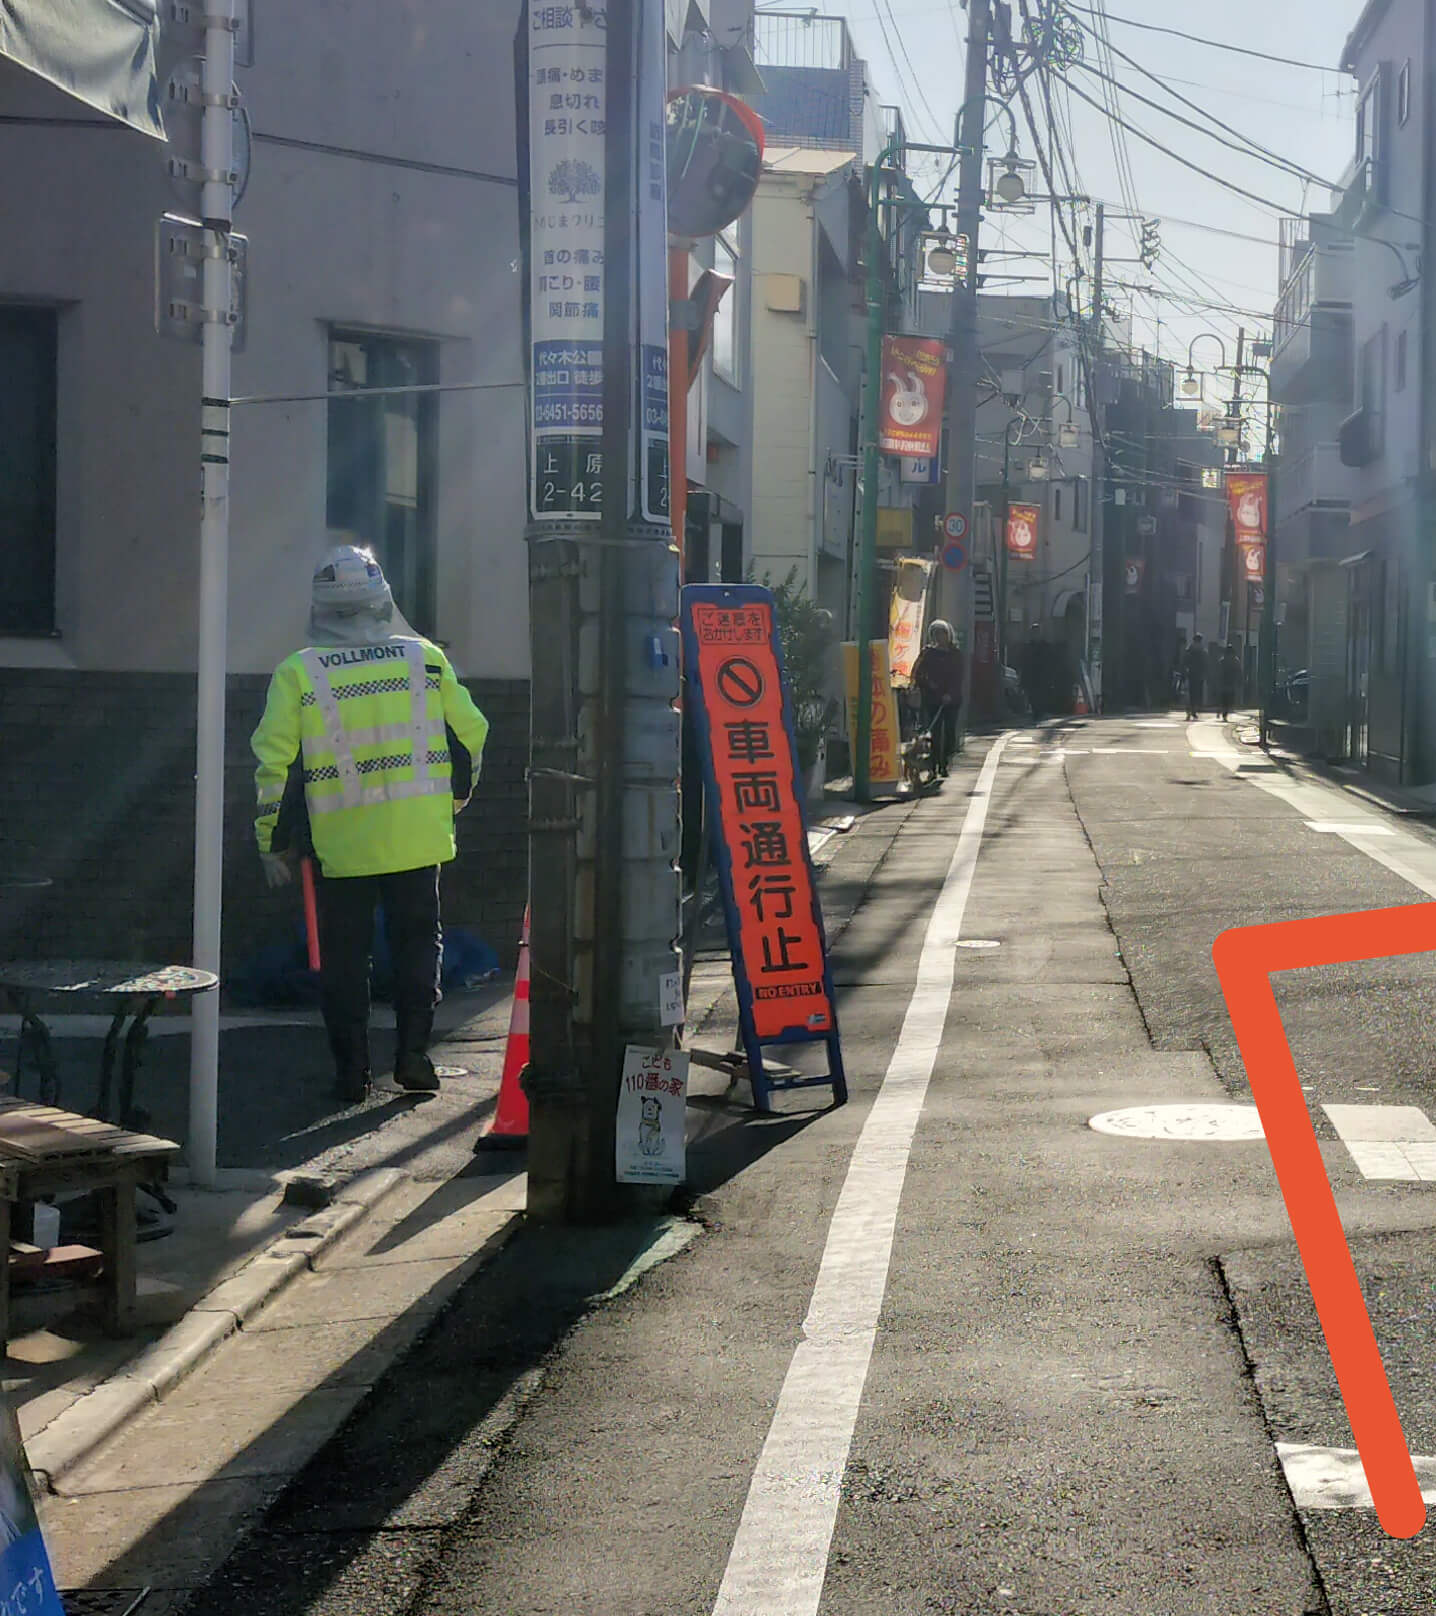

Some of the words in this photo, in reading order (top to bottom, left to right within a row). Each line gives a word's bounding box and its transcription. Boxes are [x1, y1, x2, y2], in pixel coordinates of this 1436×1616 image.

[544, 482, 603, 502] 2-42
[949, 518, 963, 533] 30
[318, 645, 406, 669] VOLLMONT
[723, 718, 809, 973] 車両通行止
[778, 983, 818, 997] ENTRY
[642, 1055, 672, 1071] こども
[626, 1072, 684, 1097] 110番の家
